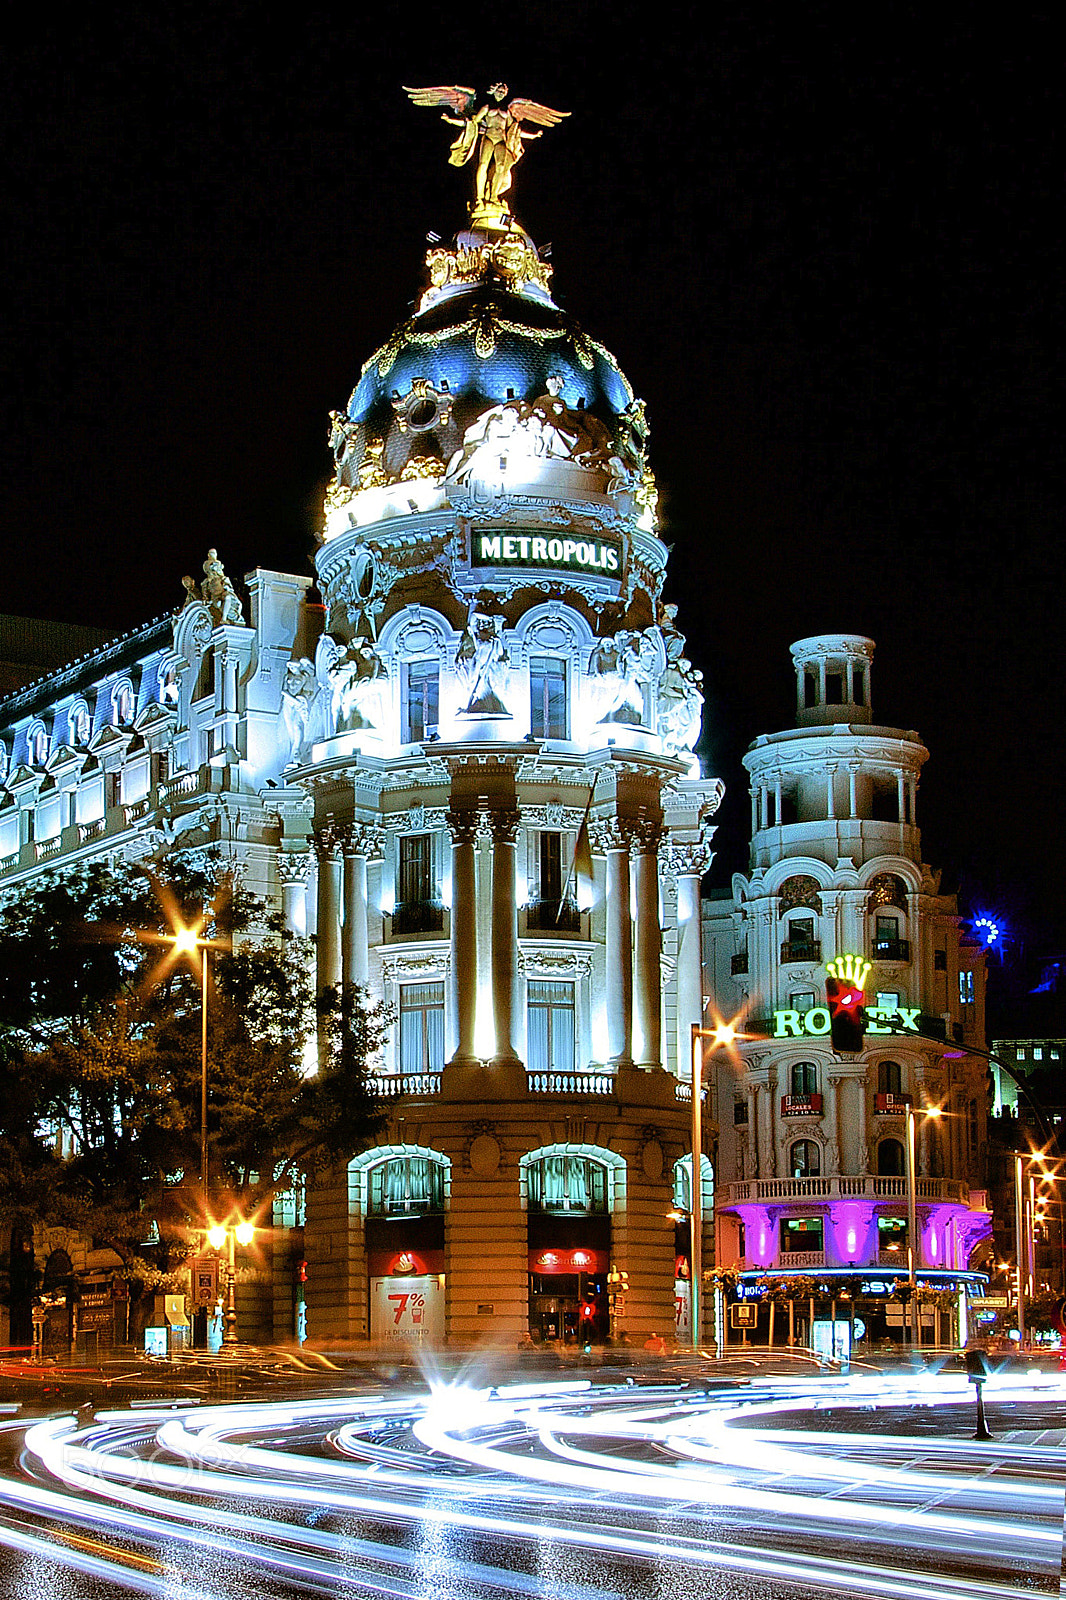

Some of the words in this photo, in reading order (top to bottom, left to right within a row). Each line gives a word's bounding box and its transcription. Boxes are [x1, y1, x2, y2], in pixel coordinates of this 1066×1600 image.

[480, 536, 618, 571] METROPOLIS
[773, 1007, 921, 1038] ROEX
[393, 1328, 430, 1336] DESCUENTO
